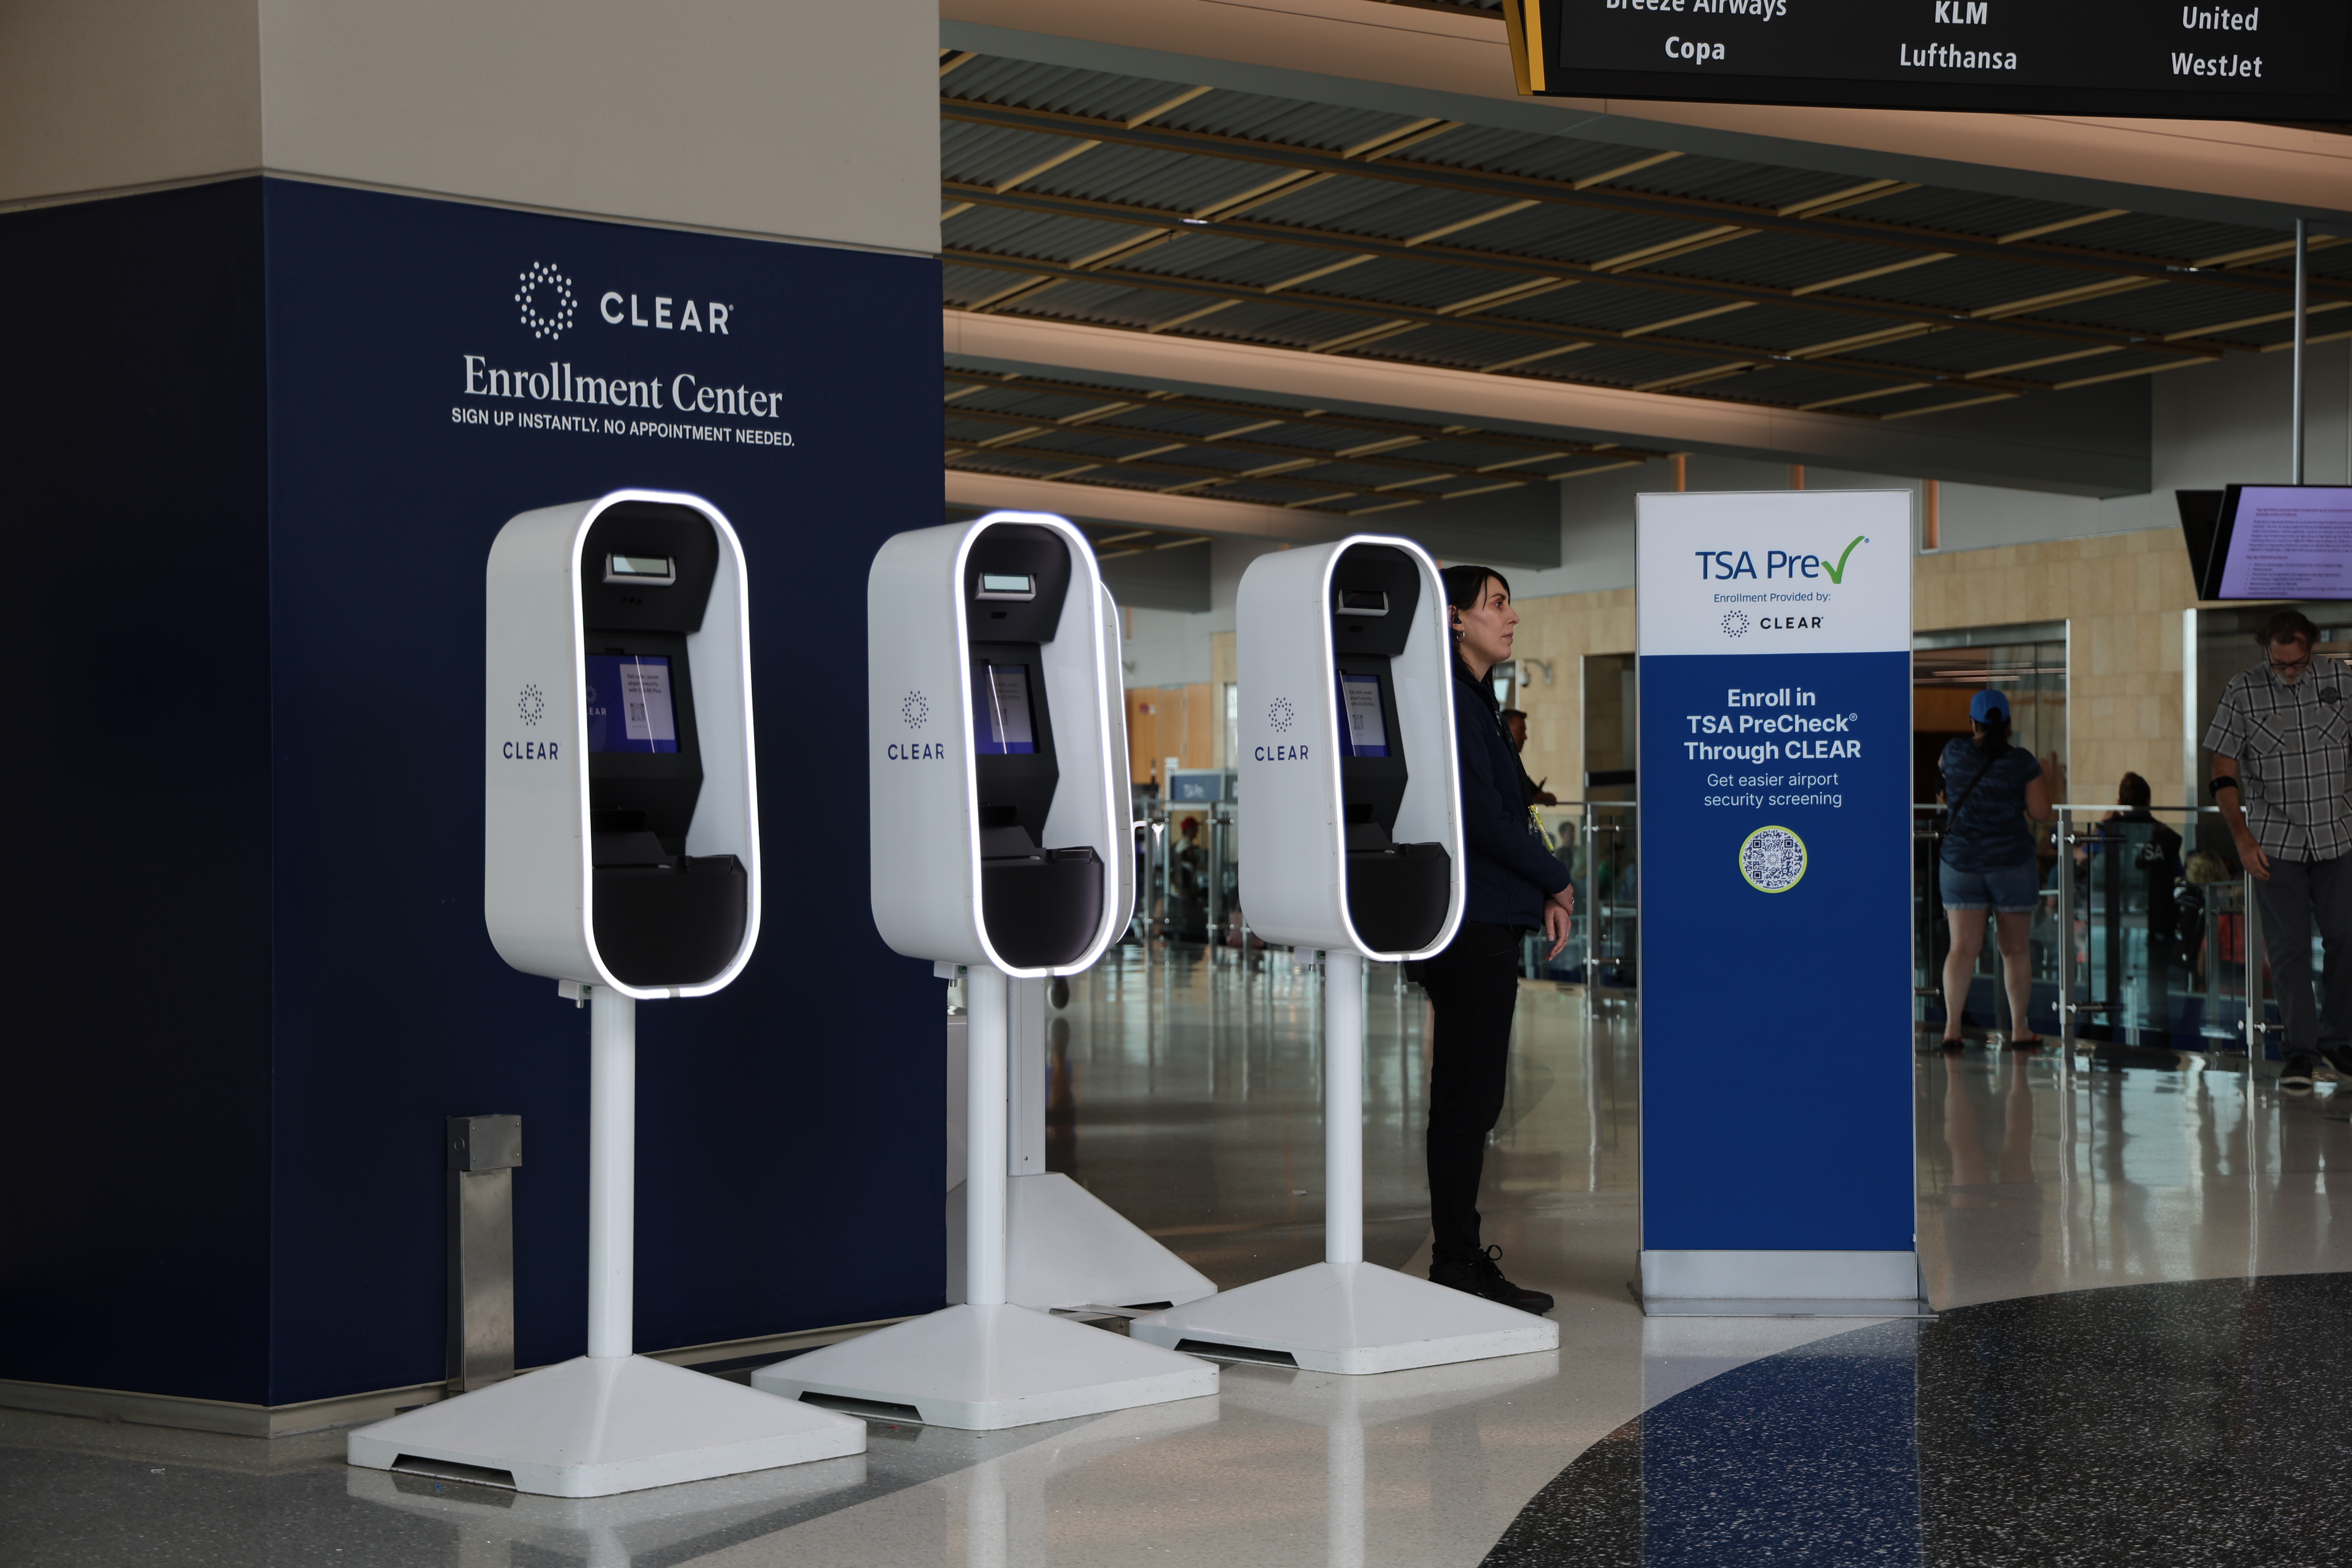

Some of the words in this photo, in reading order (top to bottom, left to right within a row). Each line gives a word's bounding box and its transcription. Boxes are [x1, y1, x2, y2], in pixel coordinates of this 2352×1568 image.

[1693, 0, 1787, 22] Airways
[1935, 1, 1987, 24] KLM
[2183, 6, 2259, 31] United
[1665, 36, 1724, 65] Copa
[1900, 43, 2016, 69] Lufthansa
[2171, 53, 2262, 77] WestJet
[463, 355, 663, 408] Enrollment
[672, 374, 782, 417] Center
[452, 408, 488, 424] SIGN
[494, 411, 514, 426] UP
[519, 412, 599, 432] INSTANTLY.
[604, 419, 626, 434] NO
[630, 421, 732, 442] APPOINTMENT
[736, 429, 795, 446] NEEDED.
[1695, 551, 1757, 580] TSA
[1714, 593, 1767, 603] Enrollment
[1770, 592, 1813, 602] Provided
[1816, 592, 1831, 602] by:
[1760, 617, 1821, 630] CLEAR
[1728, 688, 1790, 707] Enroll
[1796, 687, 1815, 706] in
[1686, 715, 1733, 733] TSA
[503, 741, 558, 760] CLEAR
[887, 743, 944, 760] CLEAR
[1255, 745, 1308, 761] CLEAR
[1684, 741, 1779, 764] Through
[1785, 740, 1861, 759] CLEAR
[1708, 773, 1733, 787] Get
[1739, 773, 1784, 786] easier
[1789, 772, 1838, 789] airport
[1704, 793, 1764, 809] security
[1769, 791, 1841, 808] screening
[2135, 843, 2165, 860] TSA
